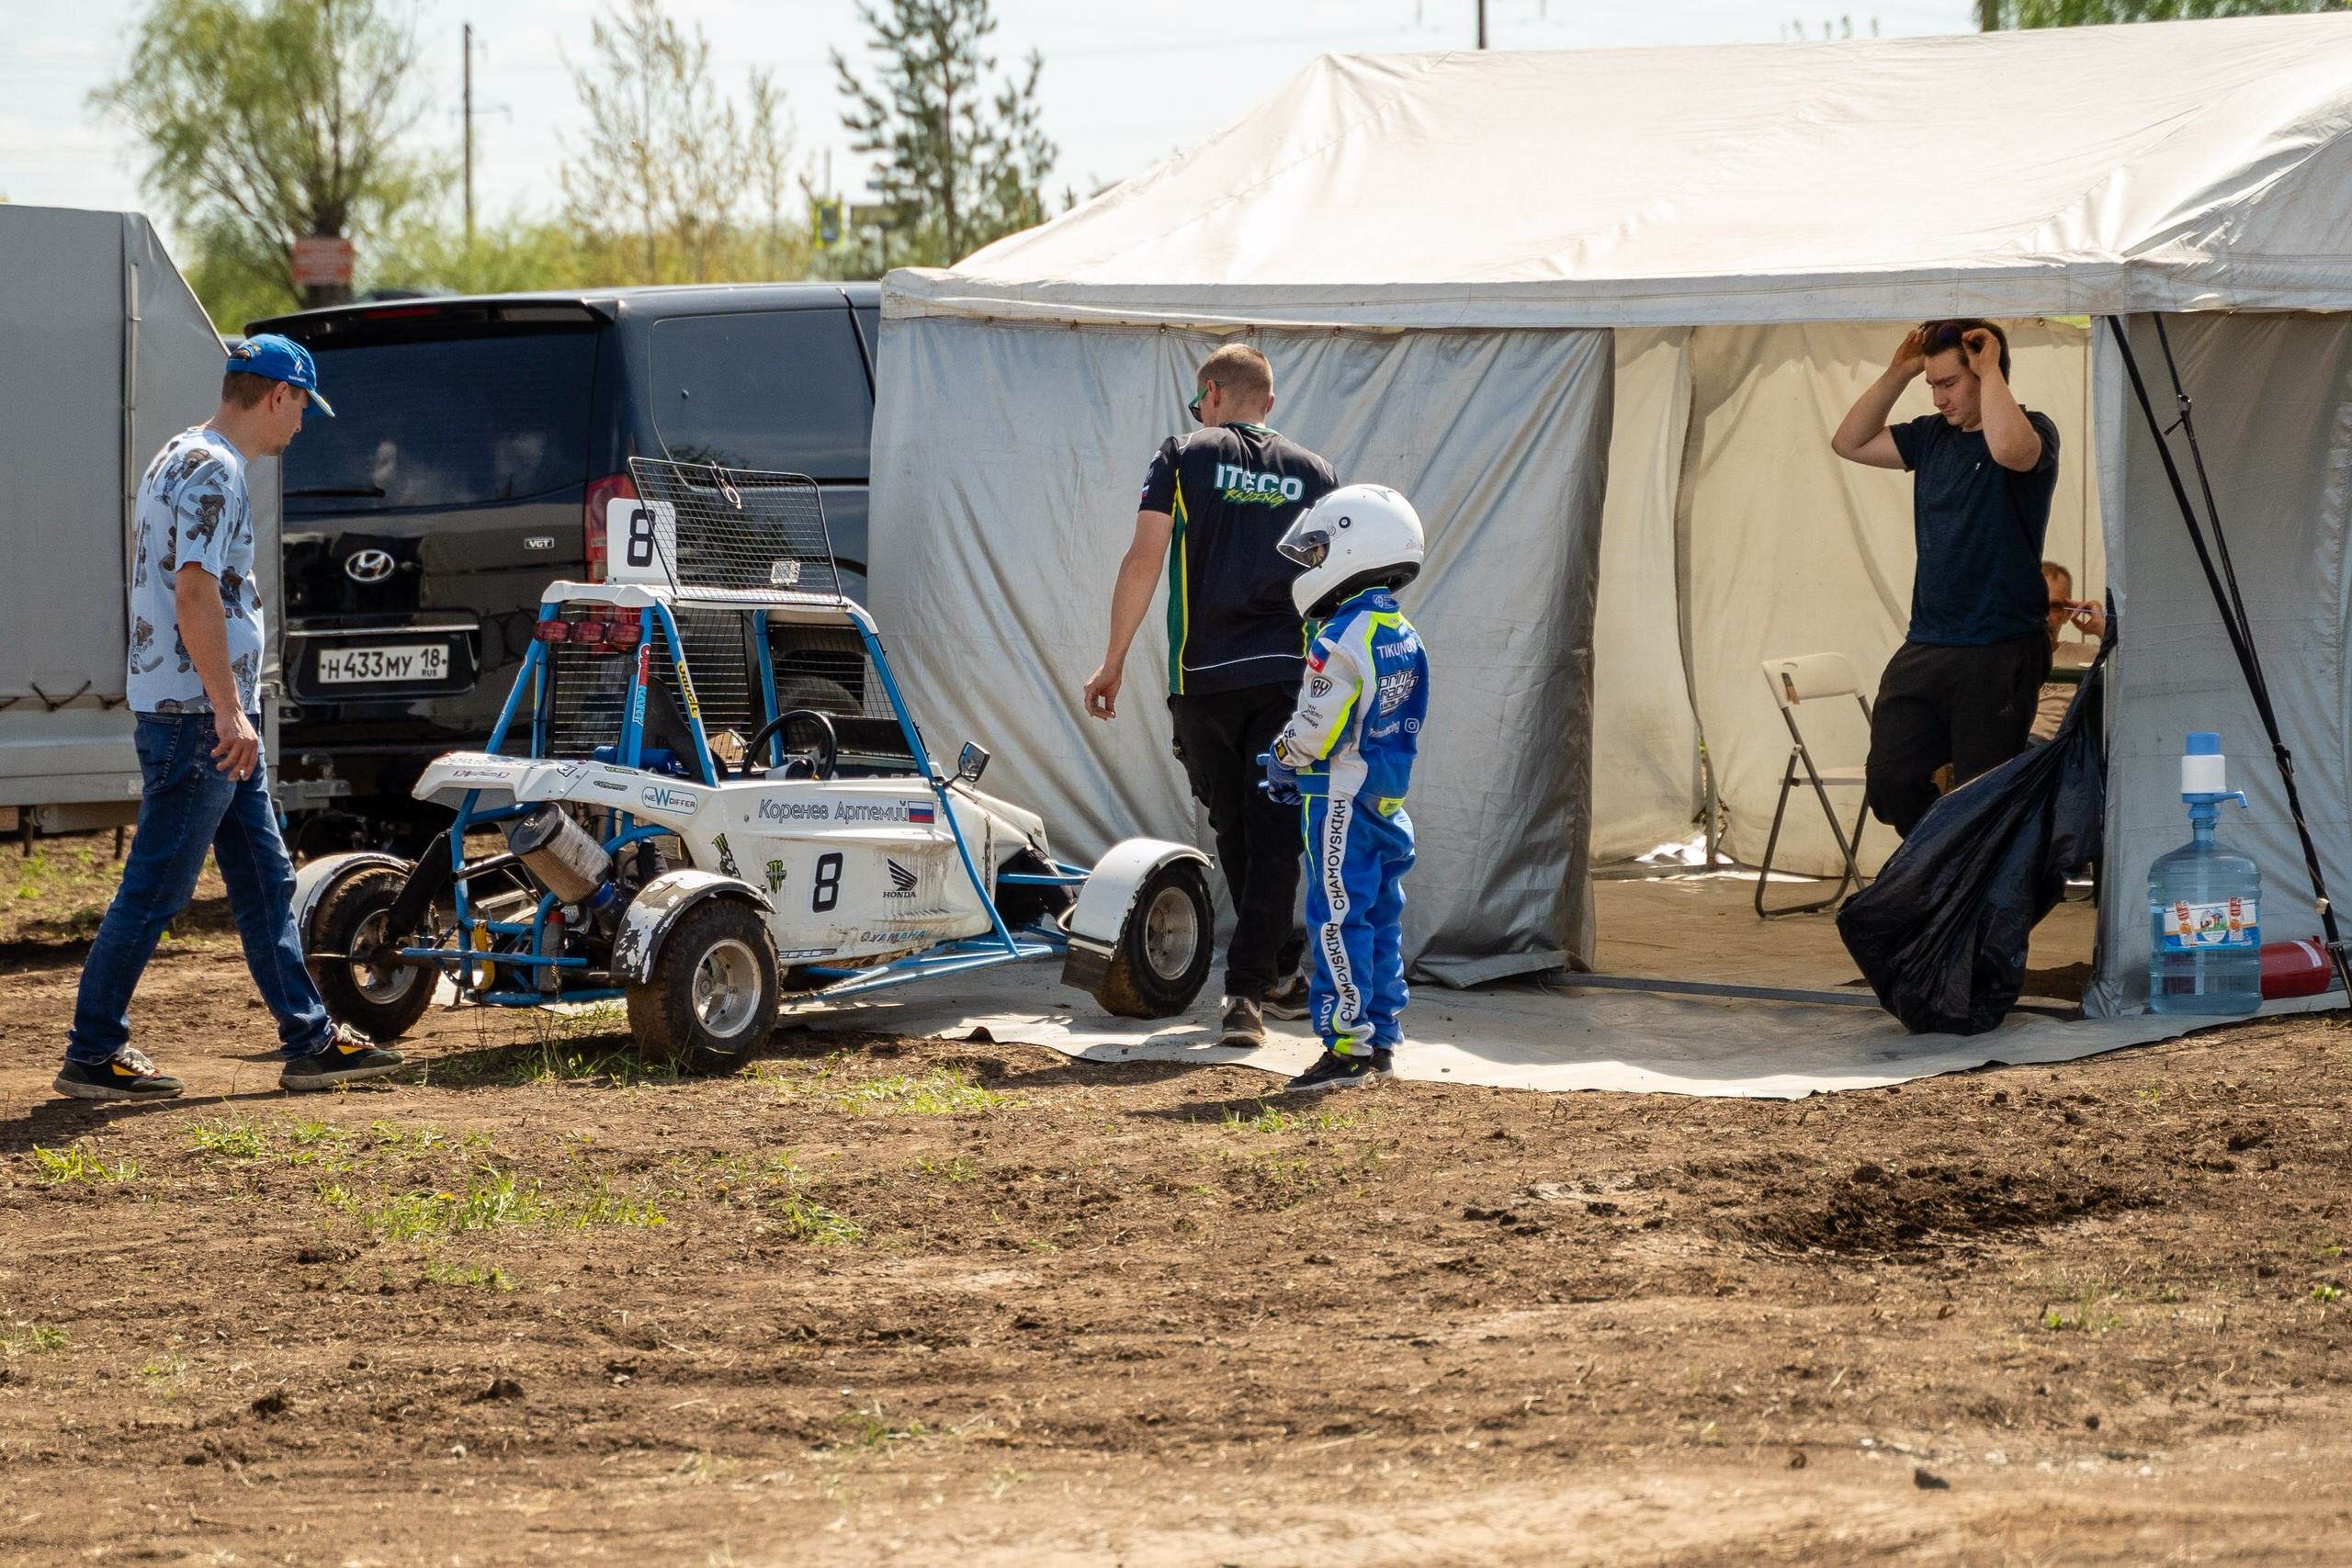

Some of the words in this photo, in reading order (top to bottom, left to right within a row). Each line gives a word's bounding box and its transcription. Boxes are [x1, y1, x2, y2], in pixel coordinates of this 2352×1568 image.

[1216, 464, 1304, 502] ITECO
[528, 539, 550, 548] VGT
[627, 508, 656, 568] 8
[420, 648, 440, 668] 18
[1376, 637, 1419, 660] TIKUNOV
[421, 669, 437, 677] RUS
[758, 799, 829, 824] Коренев
[834, 800, 909, 825] Артемий
[1327, 798, 1346, 911] CHAMOVSKIKH
[812, 852, 844, 913] 8
[869, 930, 927, 942] YAMAHA
[1327, 921, 1358, 1022] CHAMOVSKIKH
